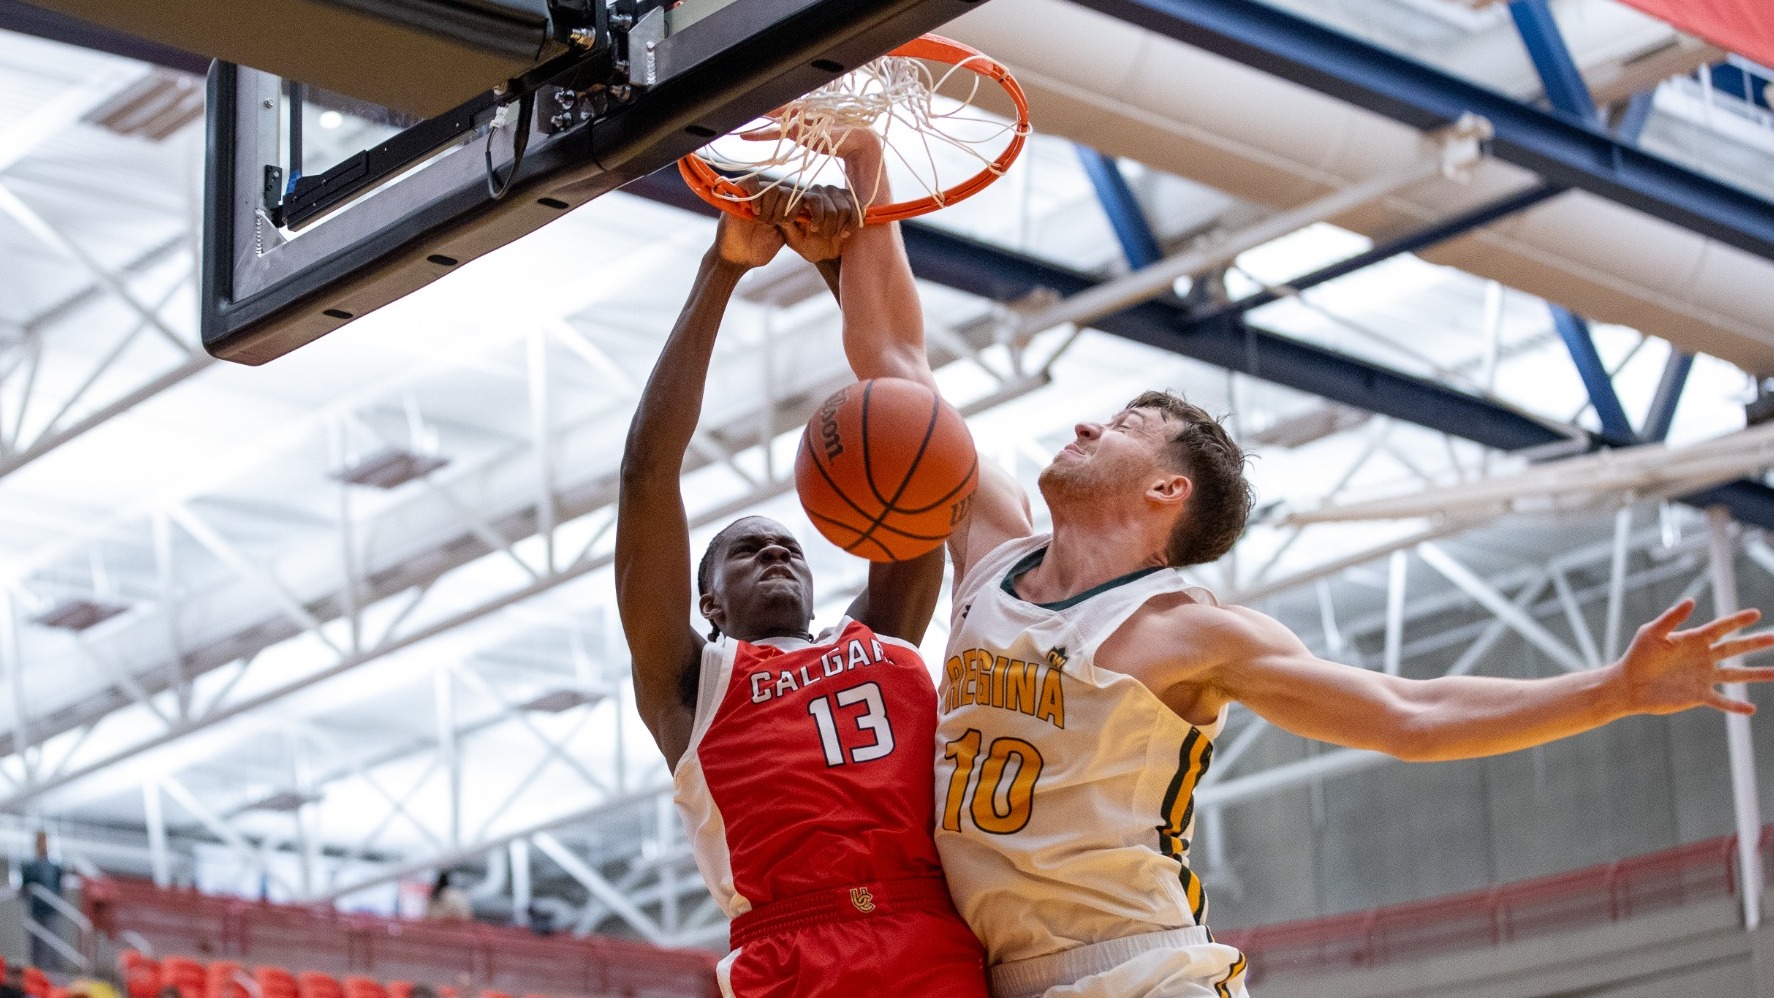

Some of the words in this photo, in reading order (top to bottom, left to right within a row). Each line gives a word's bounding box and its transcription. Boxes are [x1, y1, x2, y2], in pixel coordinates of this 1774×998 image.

[750, 638, 889, 704] CALGAR
[943, 648, 1066, 730] REGINA
[808, 682, 896, 767] 13
[941, 728, 1044, 835] 10
